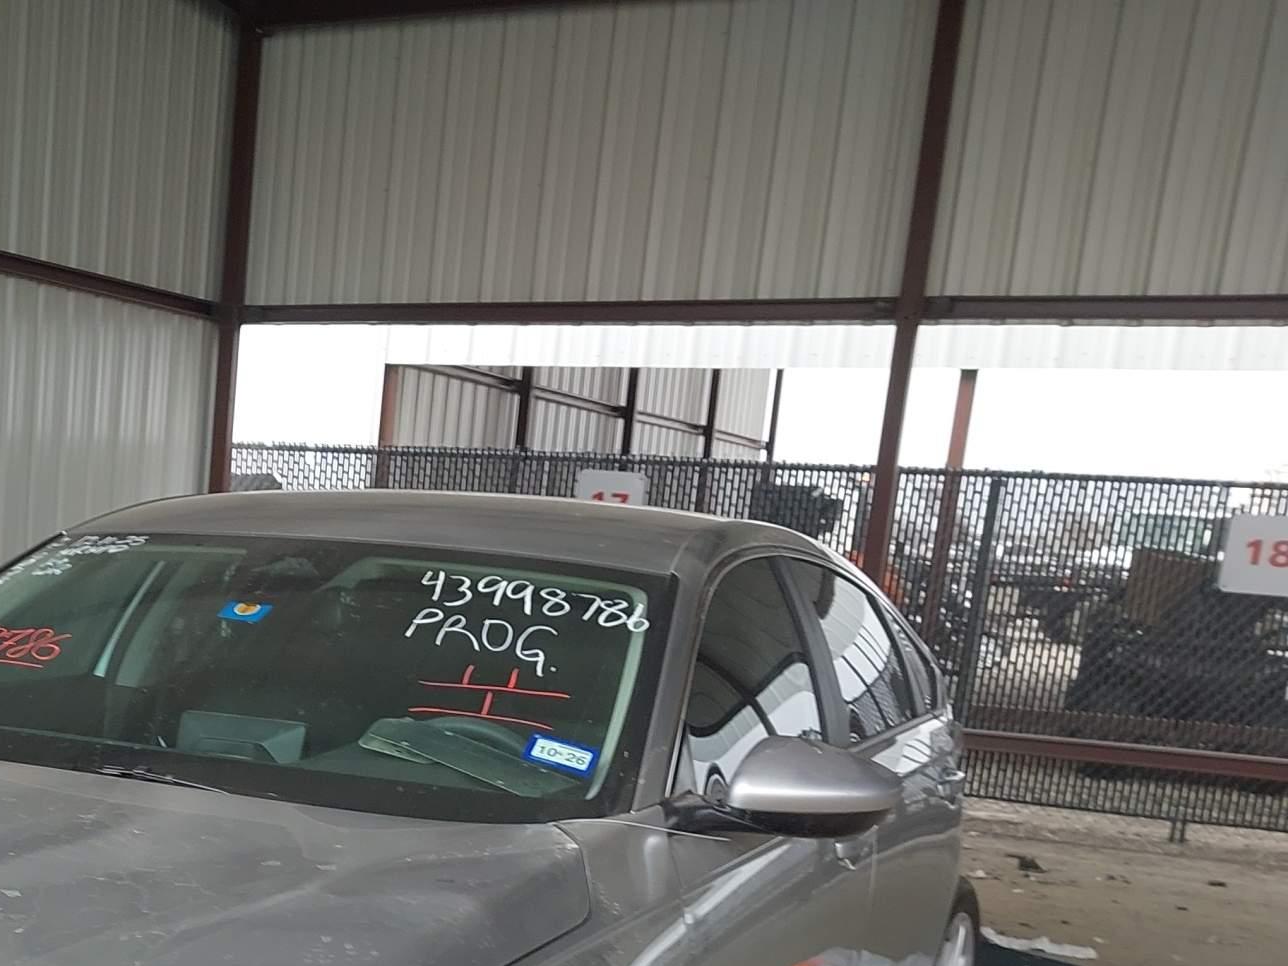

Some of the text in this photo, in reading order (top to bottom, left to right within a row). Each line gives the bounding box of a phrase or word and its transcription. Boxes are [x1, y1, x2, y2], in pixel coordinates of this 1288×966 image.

[1246, 539, 1288, 568] 18
[420, 570, 650, 632] 43998786
[404, 608, 558, 677] PROG.
